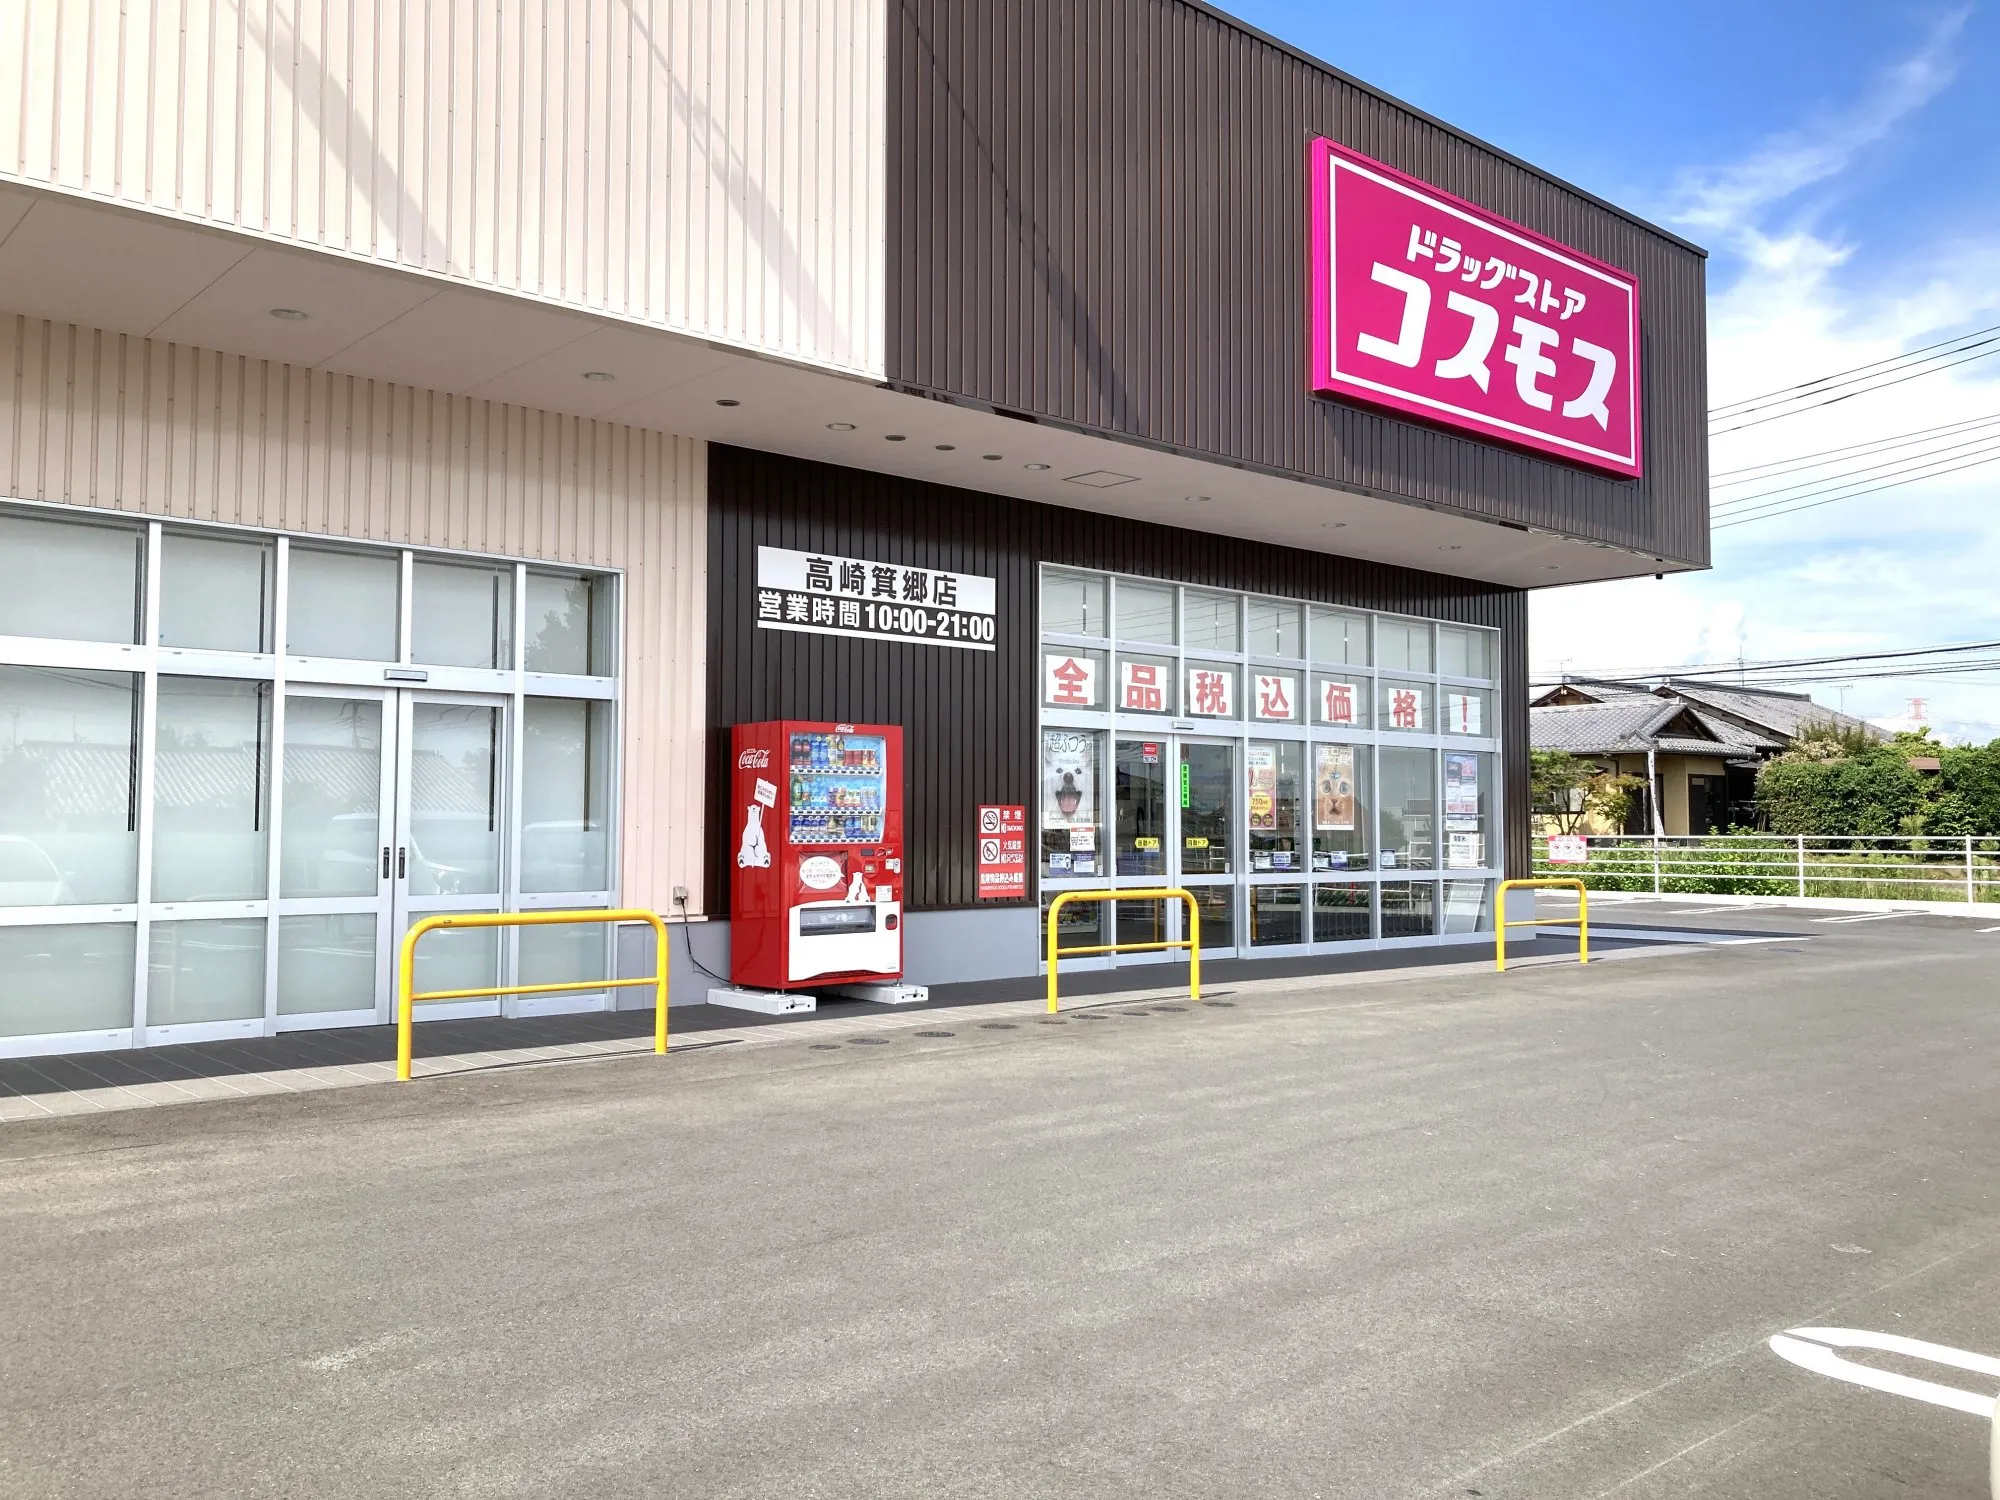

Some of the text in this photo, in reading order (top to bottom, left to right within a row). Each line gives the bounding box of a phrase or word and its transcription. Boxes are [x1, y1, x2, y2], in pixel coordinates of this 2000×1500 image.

[1406, 224, 1586, 320] ドラッグストア
[1356, 261, 1617, 432] コスモス
[806, 557, 957, 607] 高崎箕郷店
[738, 748, 770, 769] Coca-Cola
[1002, 810, 1022, 820] 禁煙
